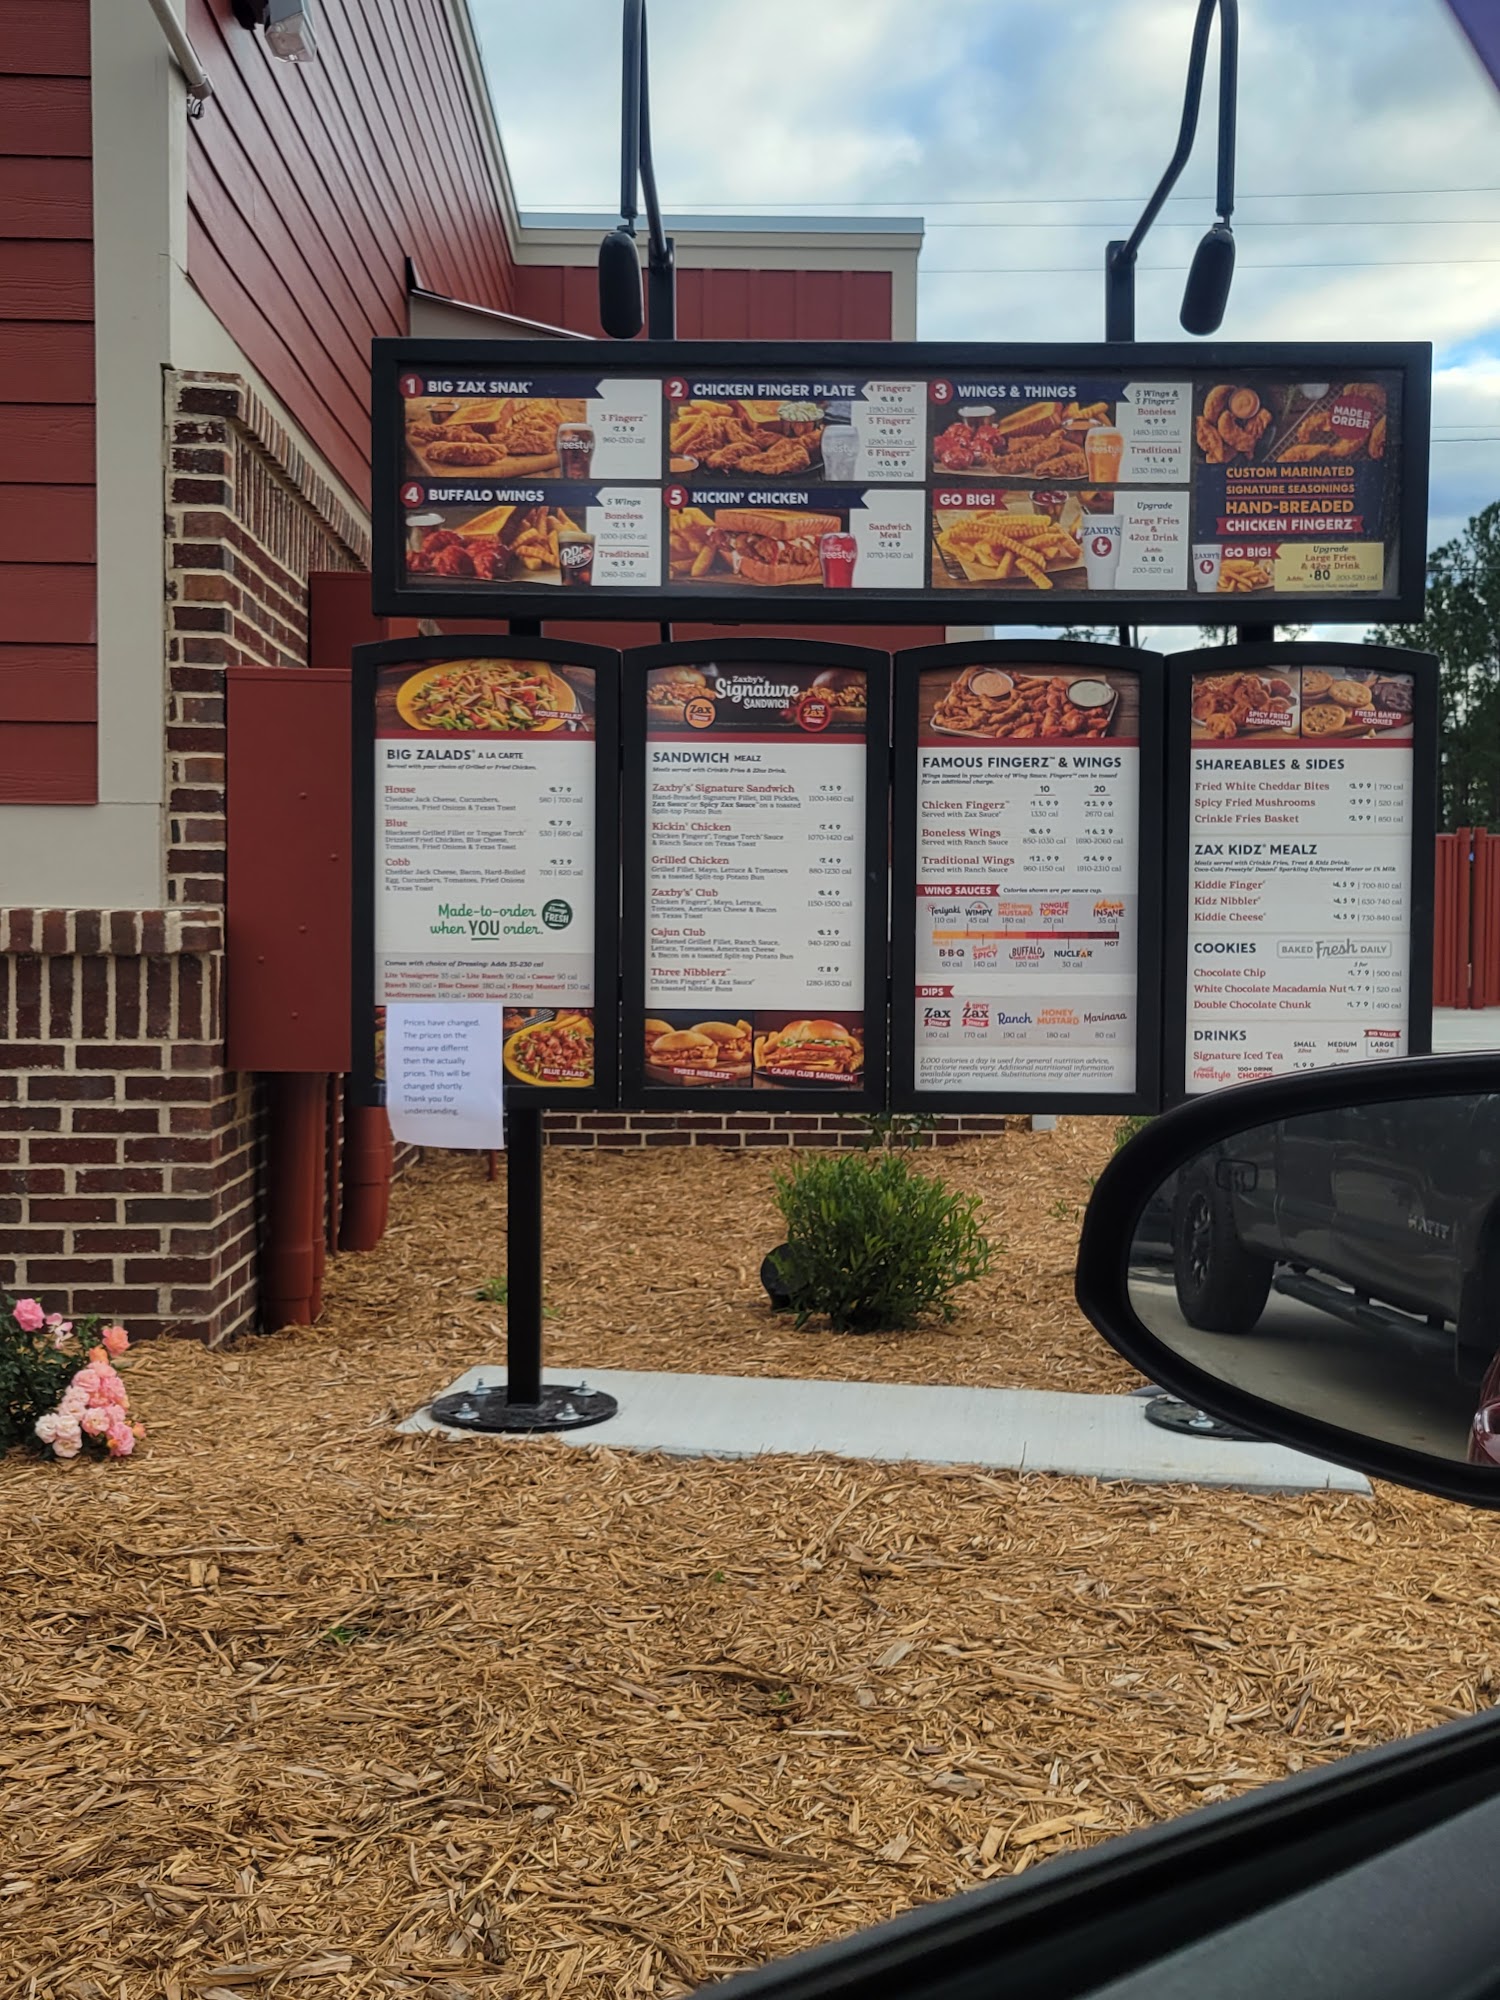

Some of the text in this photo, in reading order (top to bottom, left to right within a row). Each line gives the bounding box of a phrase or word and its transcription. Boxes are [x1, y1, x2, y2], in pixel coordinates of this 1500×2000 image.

[428, 381, 453, 393] BIG
[457, 381, 487, 393] ZAX
[693, 384, 856, 396] CHICKEN FINGER PLATE
[958, 386, 1077, 397] WINGS & THINGS
[1334, 406, 1363, 416] MADE
[1332, 415, 1370, 429] ORDER
[1130, 446, 1181, 454] Traditional
[1226, 466, 1354, 478] CUSTOM MARINATED
[1226, 484, 1355, 494] SIGNATURE SEASONINGS
[428, 490, 544, 501] BUFFALO WINGS
[692, 492, 808, 504] KICKIN' CHICKEN
[940, 494, 995, 506] GO BIG!
[614, 498, 641, 507] Wings
[1137, 502, 1172, 511] Upgrade
[1226, 501, 1354, 514] HAND-BREADED
[605, 512, 643, 520] Boneless
[1129, 517, 1179, 526] Large Fries
[1226, 520, 1287, 531] CHICKEN
[1129, 533, 1179, 542] 42oz Drink
[599, 551, 649, 559] Traditional
[1225, 548, 1271, 557] GO BIG!
[1305, 554, 1330, 562] Large
[715, 677, 799, 702] Signature
[744, 698, 789, 709] SANDWICH
[690, 705, 711, 714] Zax
[387, 749, 411, 760] BIG
[653, 752, 761, 763] SANDWICH MEALZ
[922, 757, 983, 767] FAMOUS
[1058, 757, 1067, 767] &
[1073, 757, 1121, 767] WINGS
[1195, 759, 1345, 769] SHAREABLES & SIDES
[385, 785, 416, 793] House
[695, 784, 795, 793] Signature Sandwich
[1195, 781, 1330, 790] Fried White Cheddar Bites
[922, 800, 962, 809] Chicken
[1195, 798, 1316, 808] Spicy Fried Mushrooms
[385, 819, 408, 827] Blue
[1195, 814, 1299, 823] Crinkle Fries Basket
[691, 822, 731, 831] Chicken
[922, 828, 1001, 839] Boneless Wings
[1194, 844, 1224, 854] ZAX
[1269, 844, 1318, 854] MEALZ
[385, 858, 410, 866] Cobb
[652, 855, 729, 865] Grilled Chicken
[922, 856, 1015, 866] Traditional Wings
[696, 888, 718, 897] Club
[925, 886, 991, 895] WING SAUCES
[438, 903, 537, 918] Made-to-order
[965, 907, 993, 916] WIMPY
[545, 910, 569, 923] FRESH
[430, 919, 544, 936] when YOU order.
[651, 927, 705, 937] Cajun Club
[1194, 938, 1387, 959] COOKIES BAKED Fresh DAILY
[651, 967, 680, 977] Three
[922, 987, 944, 996] DIPS
[1194, 984, 1346, 993] White Chocolate Macadamia Nut
[1194, 1000, 1311, 1009] Double Chocolate Chunk
[925, 1007, 951, 1018] Zax
[963, 1007, 989, 1018] Zax
[1042, 1008, 1073, 1016] HONEY
[1084, 1011, 1127, 1023] Marinara
[997, 1011, 1032, 1024] Ranch
[1037, 1016, 1079, 1025] MUSTARD
[448, 1019, 480, 1027] changed.
[420, 1032, 441, 1040] prices
[1194, 1029, 1246, 1041] DRINKS
[1194, 1050, 1283, 1061] Signature Iced Tea
[437, 1057, 466, 1066] actually
[404, 1070, 426, 1078] prices.
[816, 1071, 853, 1082] SANDWICH
[404, 1107, 458, 1115] understanding.
